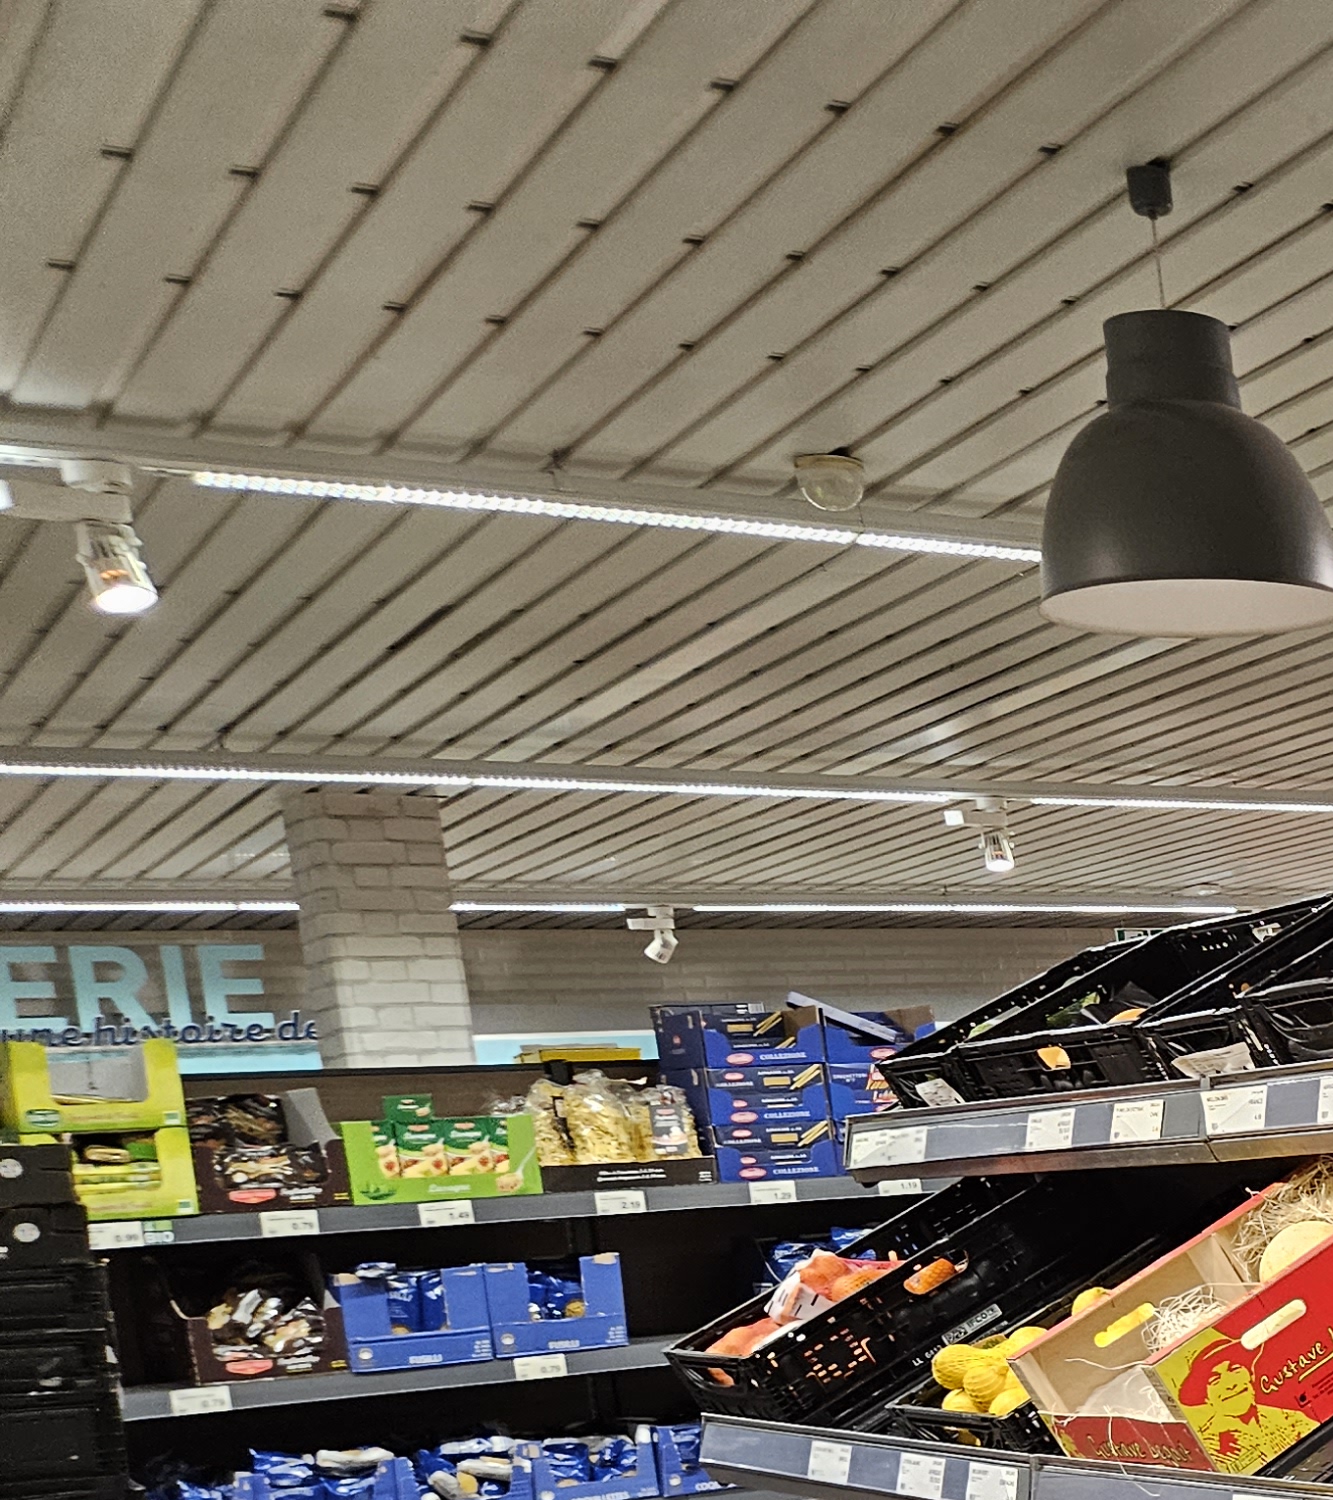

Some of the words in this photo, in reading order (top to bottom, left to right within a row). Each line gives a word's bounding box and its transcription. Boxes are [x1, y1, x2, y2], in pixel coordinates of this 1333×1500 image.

[92, 1014, 270, 1047] histoire
[899, 1181, 919, 1191] 1.19
[966, 1312, 988, 1329] IFCO
[1259, 1342, 1326, 1394] Gustave
